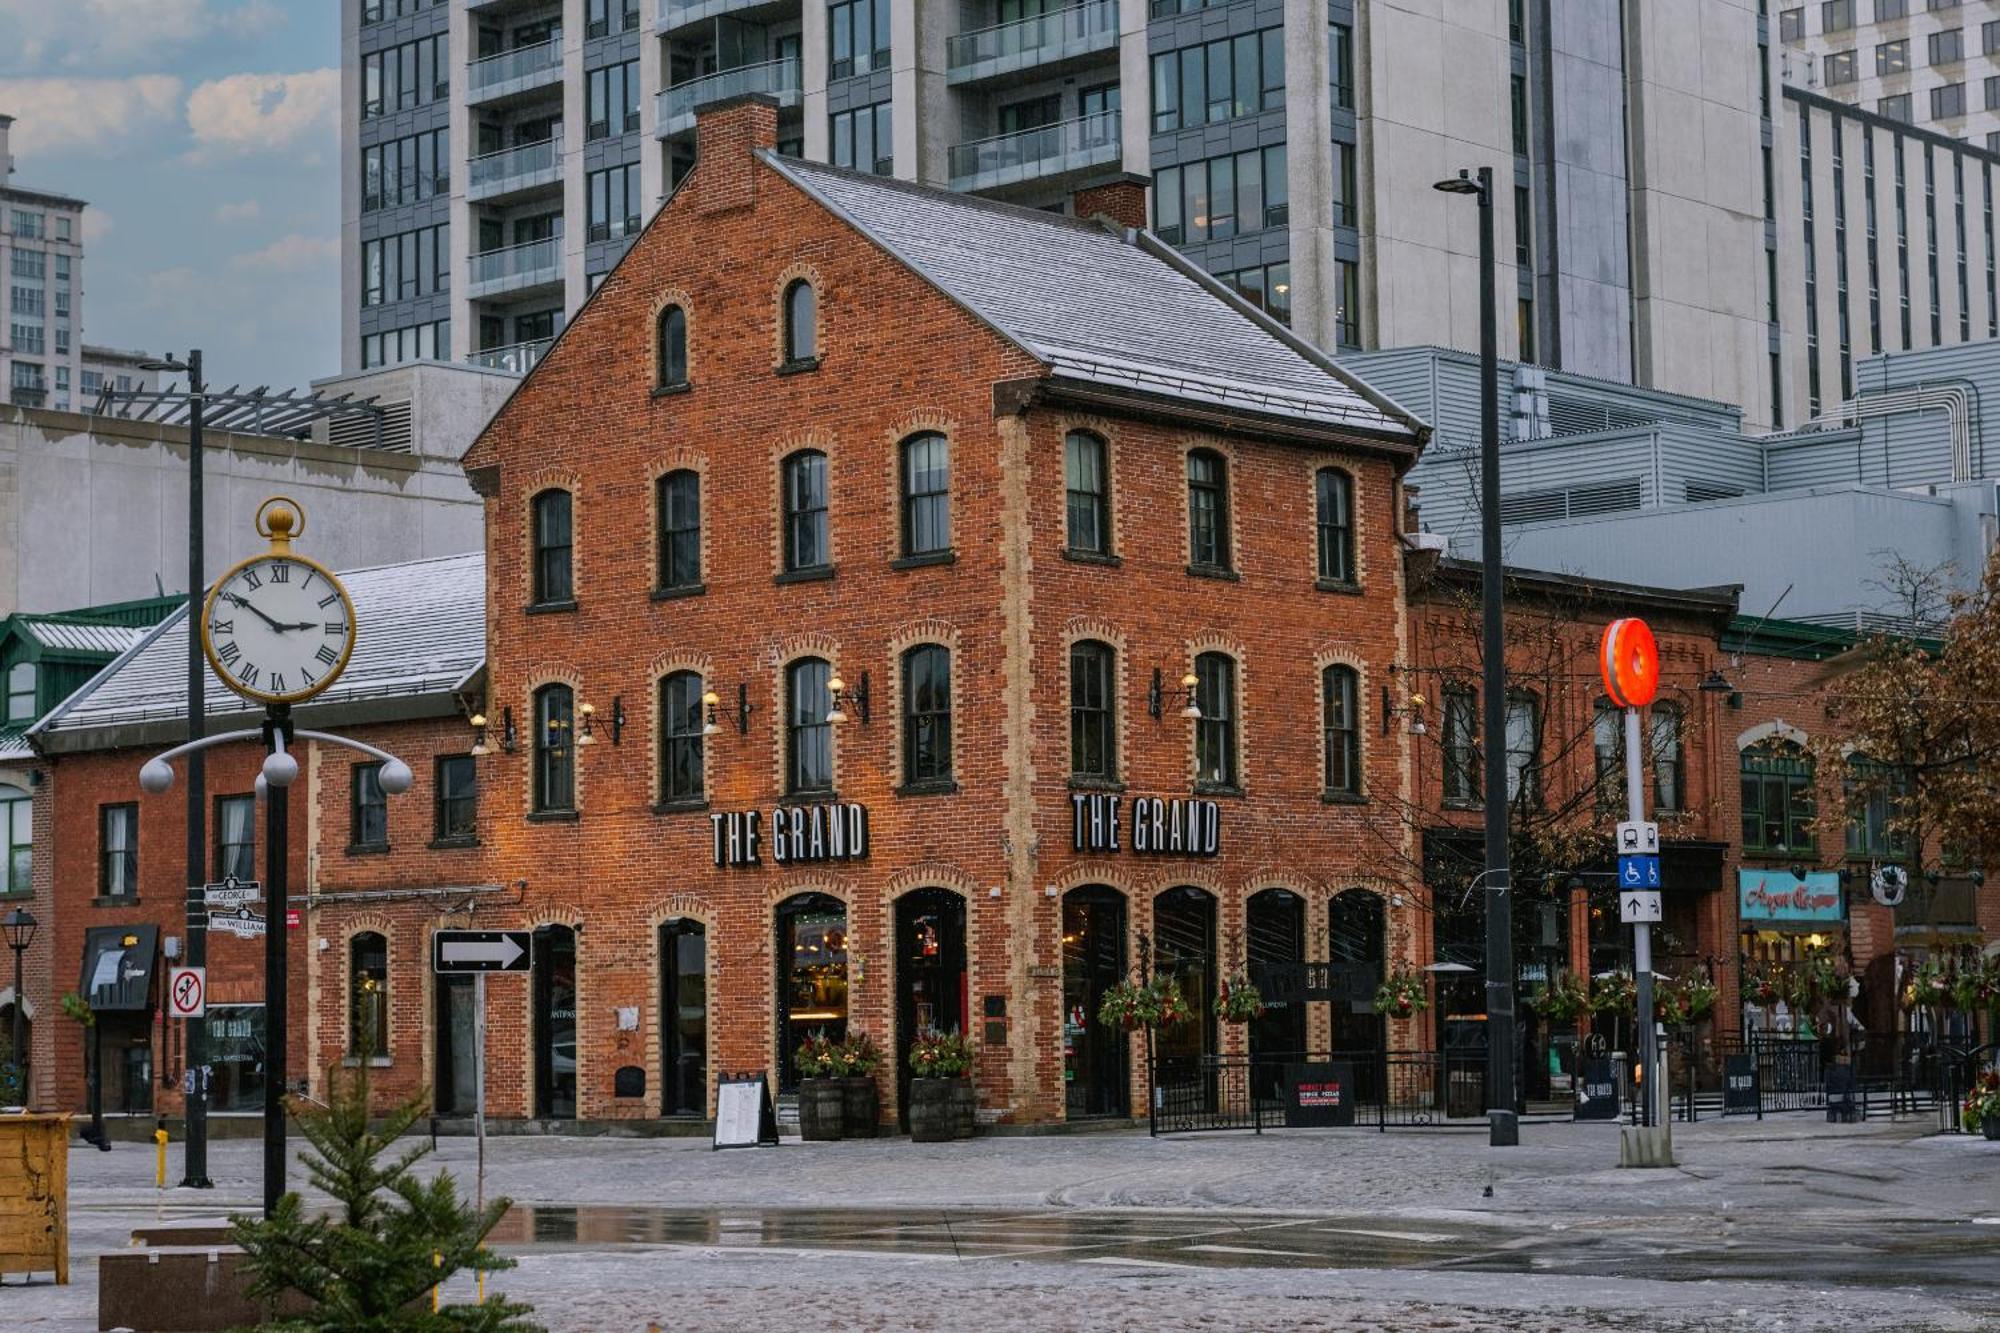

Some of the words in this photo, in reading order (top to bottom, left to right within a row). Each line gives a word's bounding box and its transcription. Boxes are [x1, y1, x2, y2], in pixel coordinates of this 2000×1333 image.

[242, 570, 262, 592] XI
[270, 565, 289, 583] XII
[302, 573, 313, 590] I
[318, 593, 338, 609] II
[215, 620, 233, 634] IX
[325, 622, 343, 635] III
[219, 641, 241, 667] VIII
[315, 644, 338, 666] IIII
[239, 662, 259, 686] VII
[271, 672, 286, 690] VI
[301, 667, 315, 684] V
[1072, 794, 1119, 850] THE
[1133, 797, 1219, 854] GRAND
[710, 811, 758, 864] THE
[772, 803, 866, 861] GRAND
[218, 890, 247, 900] GEORGE
[227, 920, 265, 931] WILLIAM
